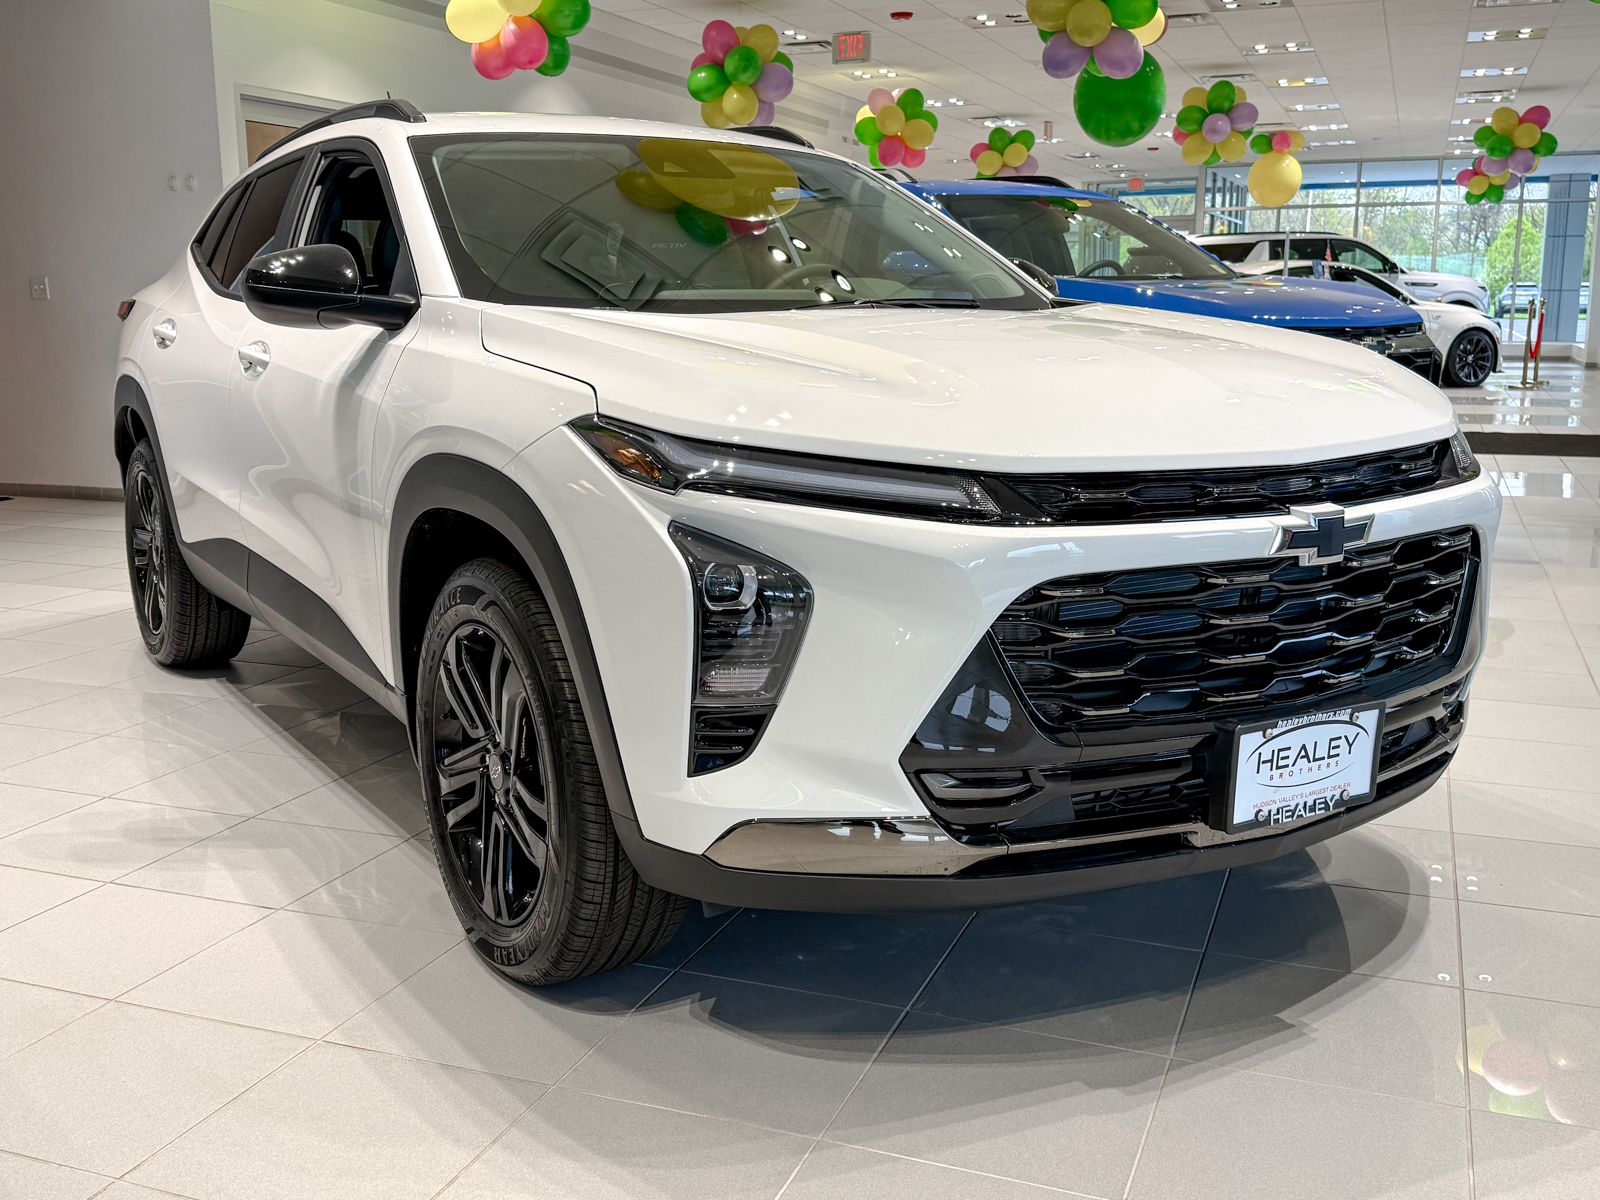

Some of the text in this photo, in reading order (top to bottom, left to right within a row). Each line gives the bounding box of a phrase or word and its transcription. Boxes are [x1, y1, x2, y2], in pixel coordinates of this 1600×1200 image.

[838, 35, 865, 58] EXIT
[1256, 732, 1361, 775] HEALEY
[1269, 760, 1340, 781] BROTHERS
[1252, 799, 1278, 810] HUDSON
[1304, 787, 1330, 798] LARGEST
[1330, 782, 1351, 793] DEALER
[1270, 796, 1336, 826] HEALEY
